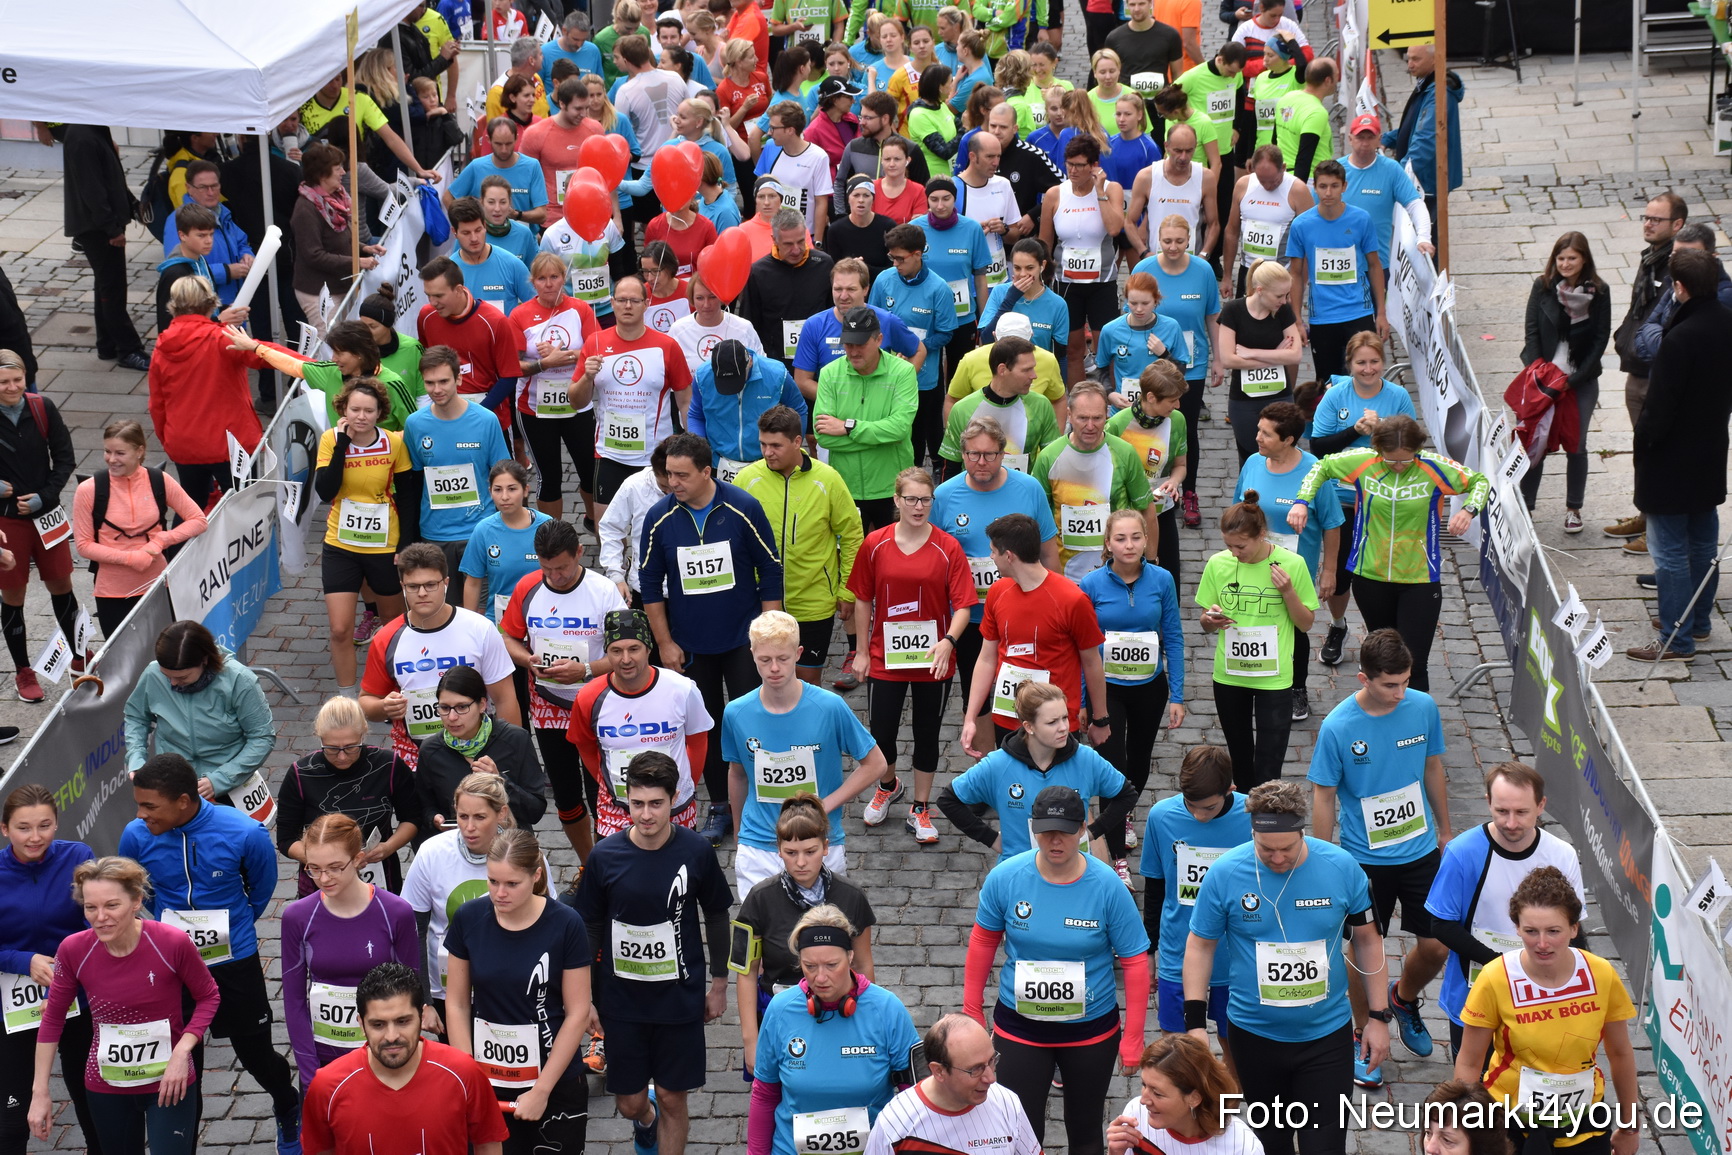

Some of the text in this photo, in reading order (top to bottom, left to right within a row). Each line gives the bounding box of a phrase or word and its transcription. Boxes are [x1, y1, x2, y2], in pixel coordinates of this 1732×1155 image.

[789, 6, 829, 18] BOCK
[1135, 81, 1159, 90] 5046
[1211, 99, 1232, 111] 5061
[384, 203, 396, 222] swn
[1246, 232, 1274, 246] 5013
[1068, 258, 1096, 270] 8017
[1321, 259, 1351, 271] 5135
[578, 277, 605, 291] 5035
[1247, 367, 1279, 381] 5025
[609, 424, 639, 439] 5158
[1490, 424, 1503, 447] swn
[235, 450, 244, 474] swn
[365, 457, 392, 467] BÖGL
[1506, 455, 1523, 478] swn
[434, 477, 470, 493] 5032
[1365, 476, 1429, 501] BOCK
[346, 514, 382, 531] 5175
[1068, 518, 1102, 534] 5241
[353, 533, 372, 541] Kathrin
[686, 557, 724, 577] 5157
[698, 577, 717, 587] Jürgen
[563, 627, 598, 637] energie
[891, 635, 930, 650] 5042
[1232, 641, 1268, 657] 5081
[1586, 635, 1609, 661] swn
[44, 649, 62, 674] swn
[905, 654, 918, 662] Anja
[1111, 647, 1150, 662] 5086
[1239, 661, 1263, 669] Caterina
[640, 732, 677, 743] energie
[1397, 734, 1426, 748] BOCK
[763, 765, 807, 784] 5239
[1373, 801, 1416, 828] 5240
[1295, 898, 1331, 907] BOCK
[1064, 918, 1099, 928] BOCK
[620, 940, 667, 960] 5248
[1267, 960, 1318, 983] 5236
[1024, 981, 1075, 1001] 5068
[1278, 987, 1313, 999] Christian
[1035, 1004, 1065, 1013] Cornelia
[1516, 1001, 1601, 1025] MAX BÖGL
[331, 1028, 356, 1038] Natalie
[108, 1041, 160, 1064] 5077
[483, 1039, 529, 1064] 8009
[841, 1046, 877, 1055] BOCK
[124, 1068, 146, 1077] Maria
[490, 1067, 521, 1078] RAIL.ONE
[805, 1130, 861, 1152] 5235
[968, 1136, 1007, 1148] NEUMARKT
